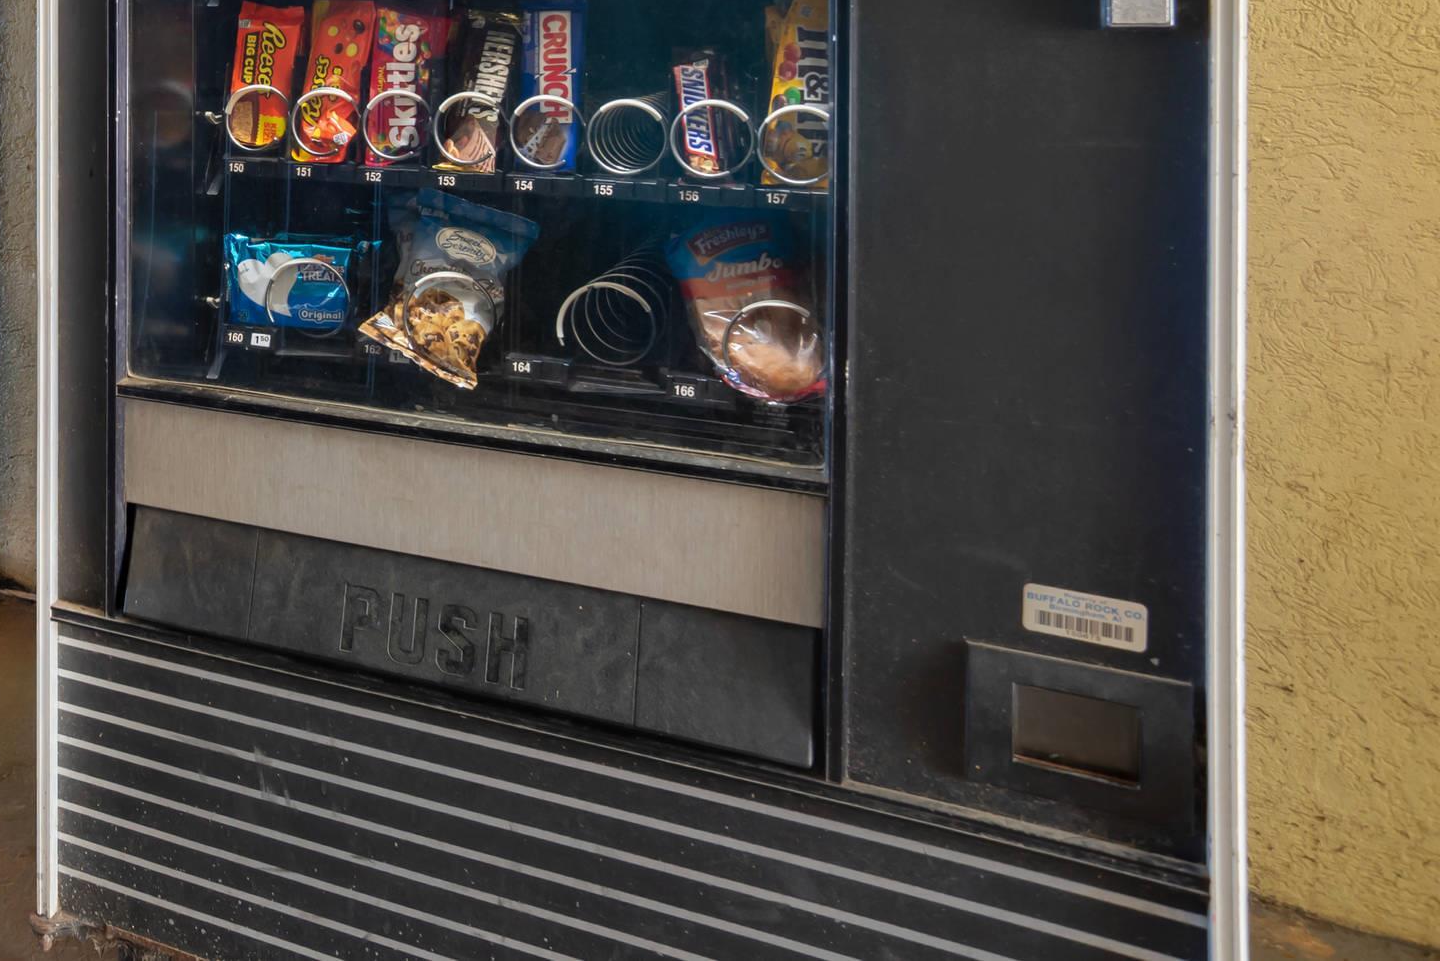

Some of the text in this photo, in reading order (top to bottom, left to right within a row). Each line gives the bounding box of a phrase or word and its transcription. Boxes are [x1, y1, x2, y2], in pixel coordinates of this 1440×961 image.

[243, 34, 257, 84] BIG CUP
[543, 14, 569, 118] CRUNCH
[229, 163, 244, 173] 150
[296, 167, 311, 177] 151
[365, 172, 381, 182] 152
[438, 176, 455, 186] 153
[514, 180, 533, 191] 154
[593, 185, 613, 196] 155
[679, 190, 699, 201] 156
[766, 193, 788, 204] 157
[707, 252, 784, 283] Jumbo
[303, 270, 341, 281] TREAT
[301, 311, 342, 321] Original
[227, 332, 244, 343] 160
[364, 344, 382, 354] 162
[512, 362, 531, 373] 164
[674, 385, 695, 397] 166
[1026, 591, 1145, 621] BUFFALO ROCK CO.
[339, 582, 529, 690] PUSH
